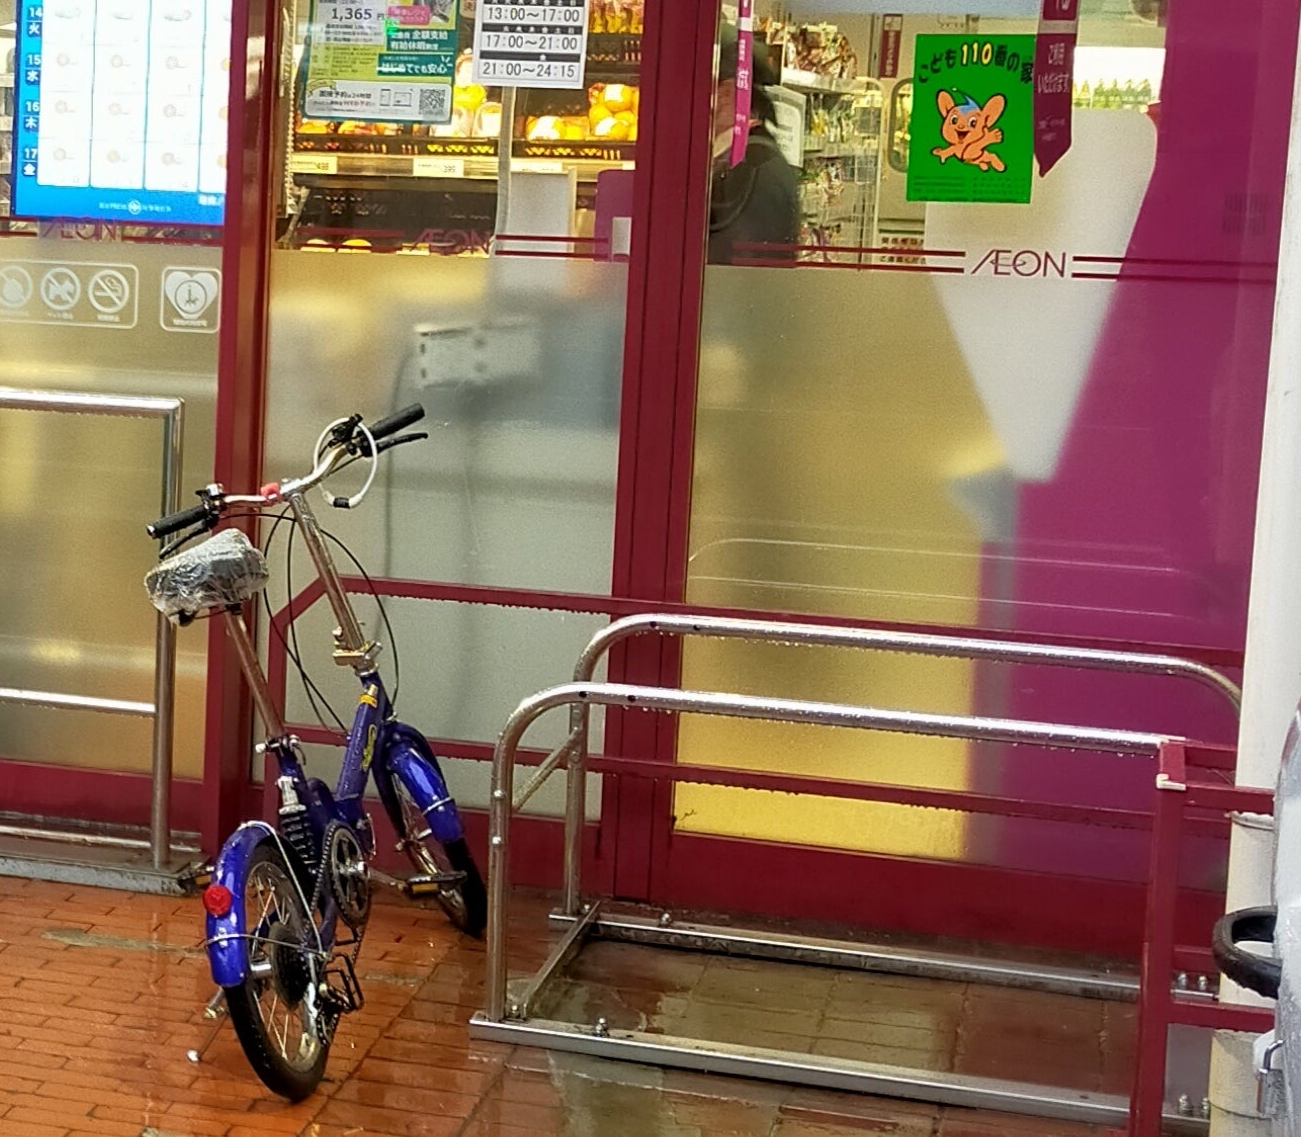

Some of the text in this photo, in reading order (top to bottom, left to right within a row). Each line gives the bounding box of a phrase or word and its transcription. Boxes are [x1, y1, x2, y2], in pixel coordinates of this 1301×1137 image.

[29, 7, 42, 18] 14
[331, 8, 373, 21] 1,365
[27, 54, 41, 65] 15
[26, 101, 40, 112] 16
[24, 148, 37, 160] 17
